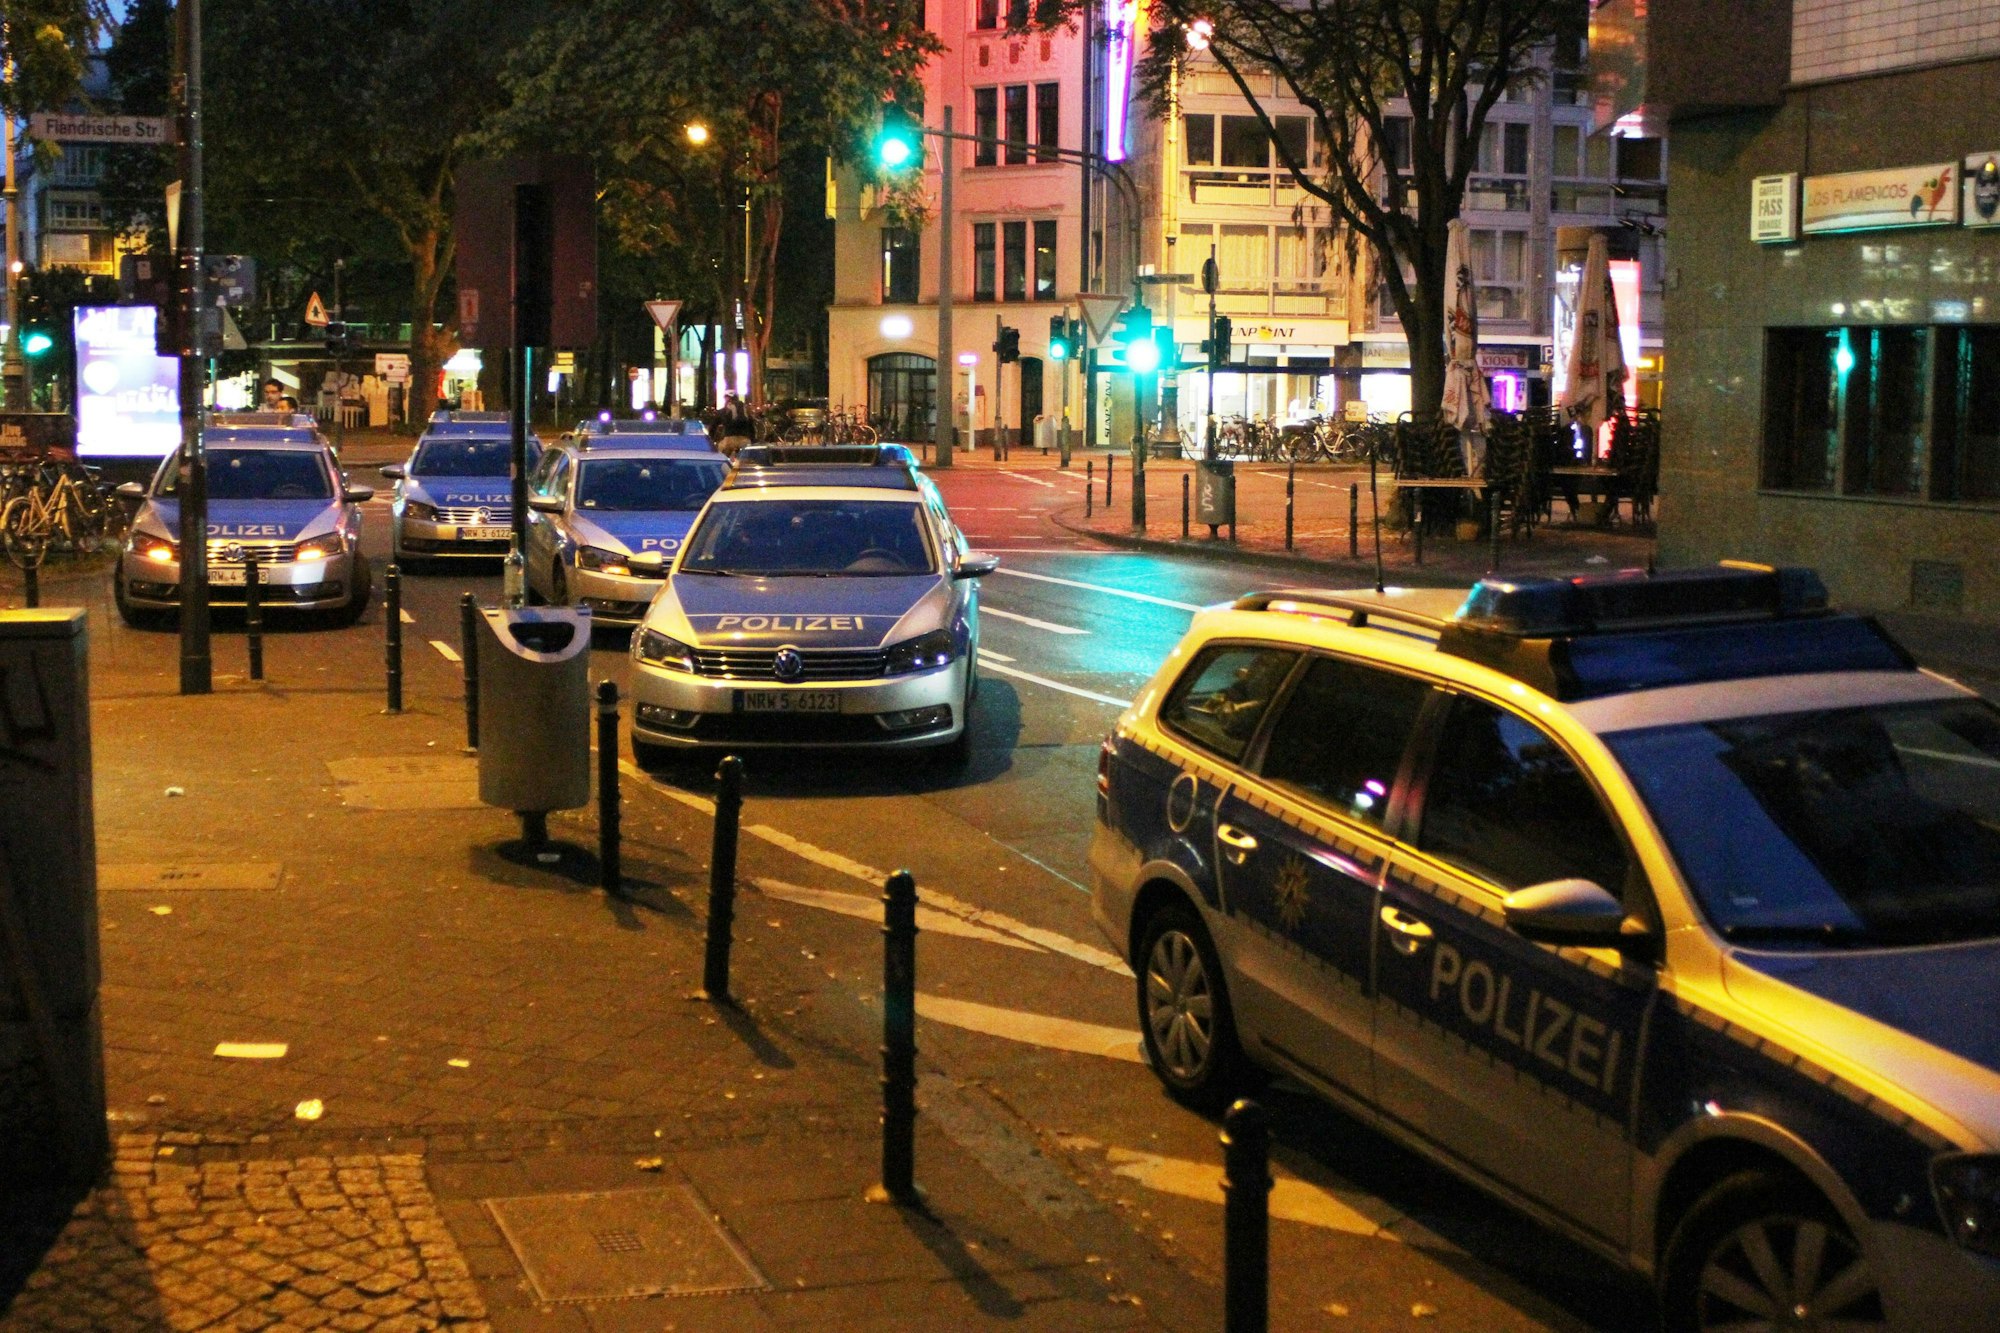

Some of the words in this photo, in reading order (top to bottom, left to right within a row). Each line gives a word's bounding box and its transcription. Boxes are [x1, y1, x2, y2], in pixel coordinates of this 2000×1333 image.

[46, 118, 131, 136] Flandrische
[135, 121, 161, 137] Str.
[1834, 183, 1909, 204] FLAMENCOS
[1759, 198, 1782, 216] FASS
[1482, 355, 1514, 366] KIOSK
[446, 494, 512, 502] POLIZE
[206, 524, 285, 536] OLIZEI
[483, 530, 488, 538] 5
[716, 616, 864, 631] POLIZEI
[746, 693, 775, 710] NRW
[780, 693, 789, 710] 5
[799, 693, 836, 711] 6123
[1431, 943, 1622, 1096] POLIZEI
